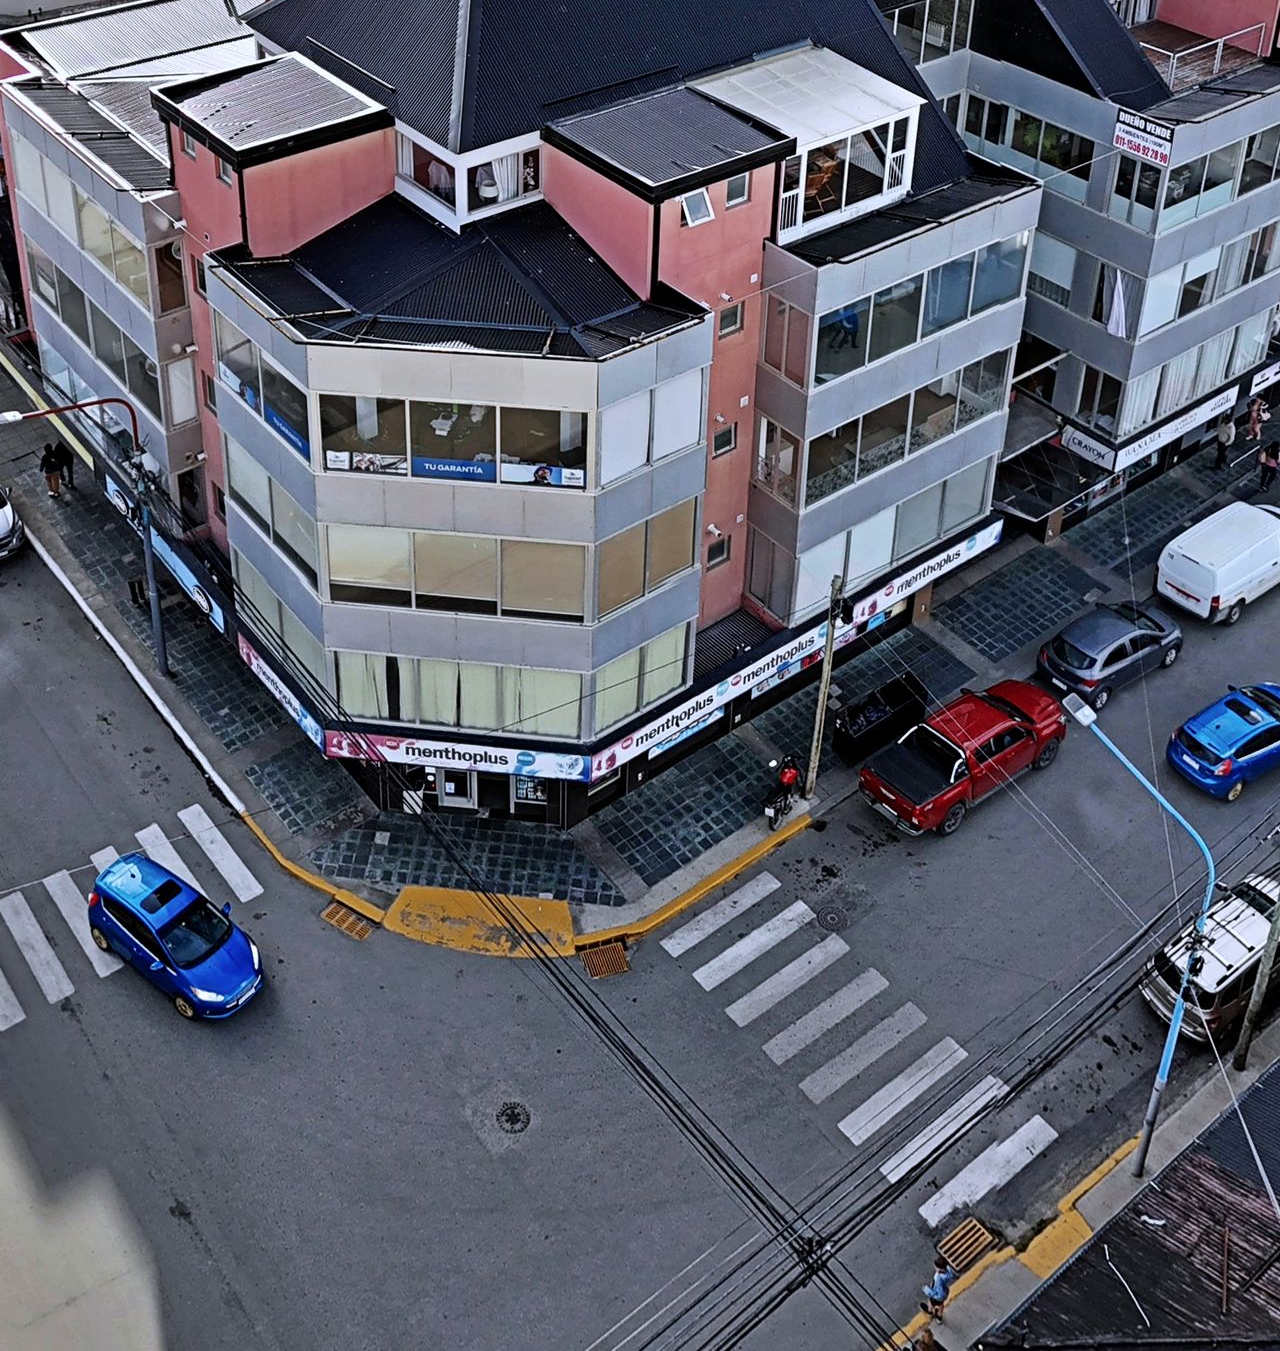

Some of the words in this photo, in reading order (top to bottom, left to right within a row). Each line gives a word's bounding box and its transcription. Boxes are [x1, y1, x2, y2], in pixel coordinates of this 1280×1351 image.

[1119, 111, 1145, 130] DUEÑO
[1146, 121, 1172, 140] VENDE
[1122, 128, 1149, 143] AMBIENTES
[1114, 134, 1141, 153] 011-1556
[1141, 145, 1150, 157] 92
[1150, 148, 1159, 160] 28
[1159, 152, 1168, 164] 90
[1071, 436, 1105, 461] CRAYON
[424, 462, 436, 471] TU
[437, 463, 483, 475] GARANTÍA
[896, 549, 961, 595] menthoplus
[742, 635, 815, 685] menthoplus
[635, 694, 714, 747] menthoplus
[405, 742, 509, 767] menthoplus
